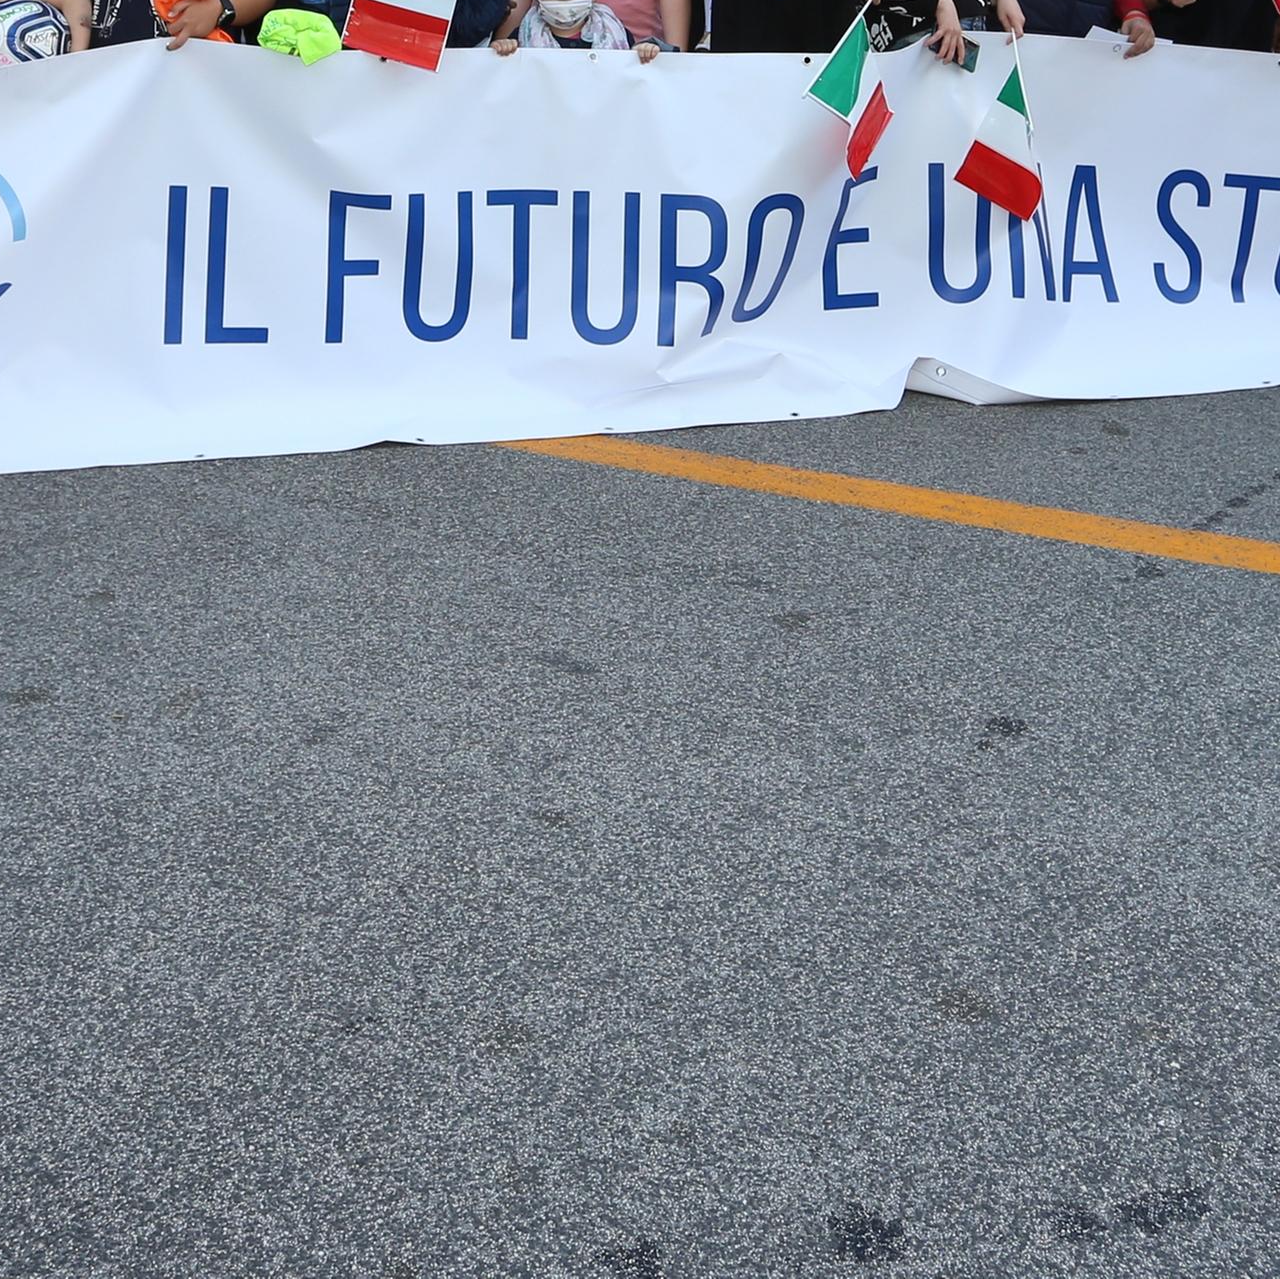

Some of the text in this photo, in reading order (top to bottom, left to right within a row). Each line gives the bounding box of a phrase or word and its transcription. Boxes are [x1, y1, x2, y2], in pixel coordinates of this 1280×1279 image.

[163, 185, 269, 345] IL
[324, 188, 806, 347] FUTURO
[927, 162, 1120, 304] UNA
